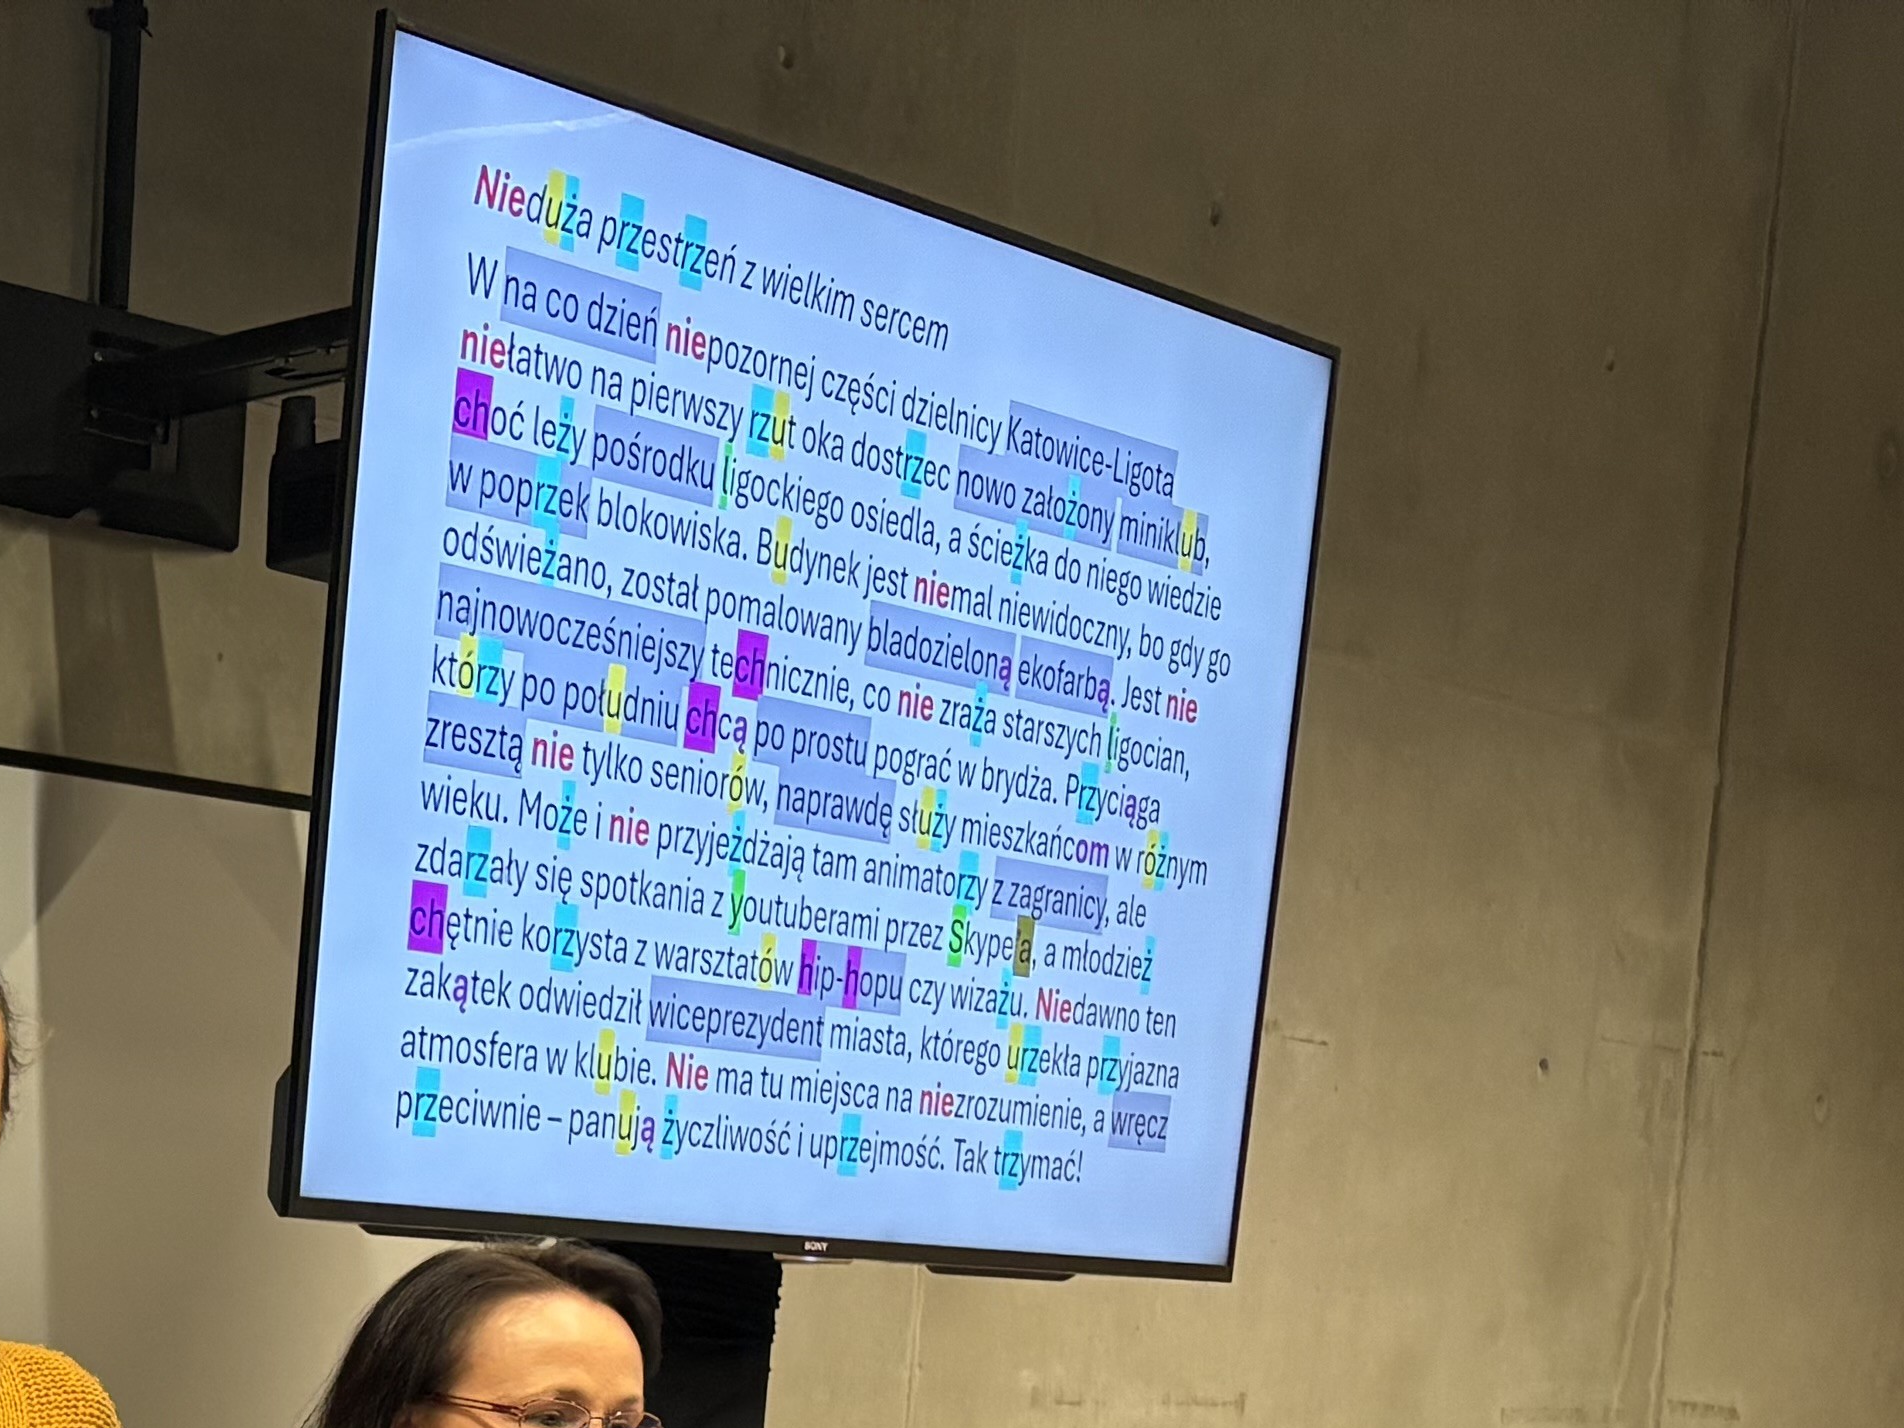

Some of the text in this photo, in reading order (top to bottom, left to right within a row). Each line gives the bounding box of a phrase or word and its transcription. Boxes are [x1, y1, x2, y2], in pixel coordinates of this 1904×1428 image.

[473, 163, 948, 351] Nieduża przestrzeń z wielkim sercem
[459, 321, 1209, 576] niełatwo na pierwszy rzut oka dostrzec nowo założony miniklub,
[467, 251, 1175, 499] W na co dzień niepozornej części dzielnicy Katowice-Ligota
[452, 387, 1221, 621] choć leży pośrodku ligockiego osiedla, a ścieżka do niego wiedzie
[434, 578, 1189, 782] najnowocześniejszy technicznie, co nie zraża starszych ligocian,
[440, 521, 1197, 723] odświeżano, został pomalowany bladozieloną ekofarbą. Jest nie
[423, 708, 1207, 890] zresztą nie tylko seniorów, naprawdę służy mieszkańcom w różnym
[404, 960, 1179, 1099] zakątek odwiedził wiceprezydent miasta, którego urzekła przyjazna
[407, 897, 1176, 1038] chętnie korzysta z warsztatów hip-hopu czy wizażu. Niedawno ten
[395, 1087, 541, 1135] przeciwnie
[567, 1104, 655, 1154] panują
[661, 1108, 791, 1158] życzliwość
[797, 1121, 803, 1157] i
[809, 1129, 944, 1175] uprzejmość.
[953, 1137, 988, 1175] Tak
[993, 1145, 1083, 1190] trzymać!
